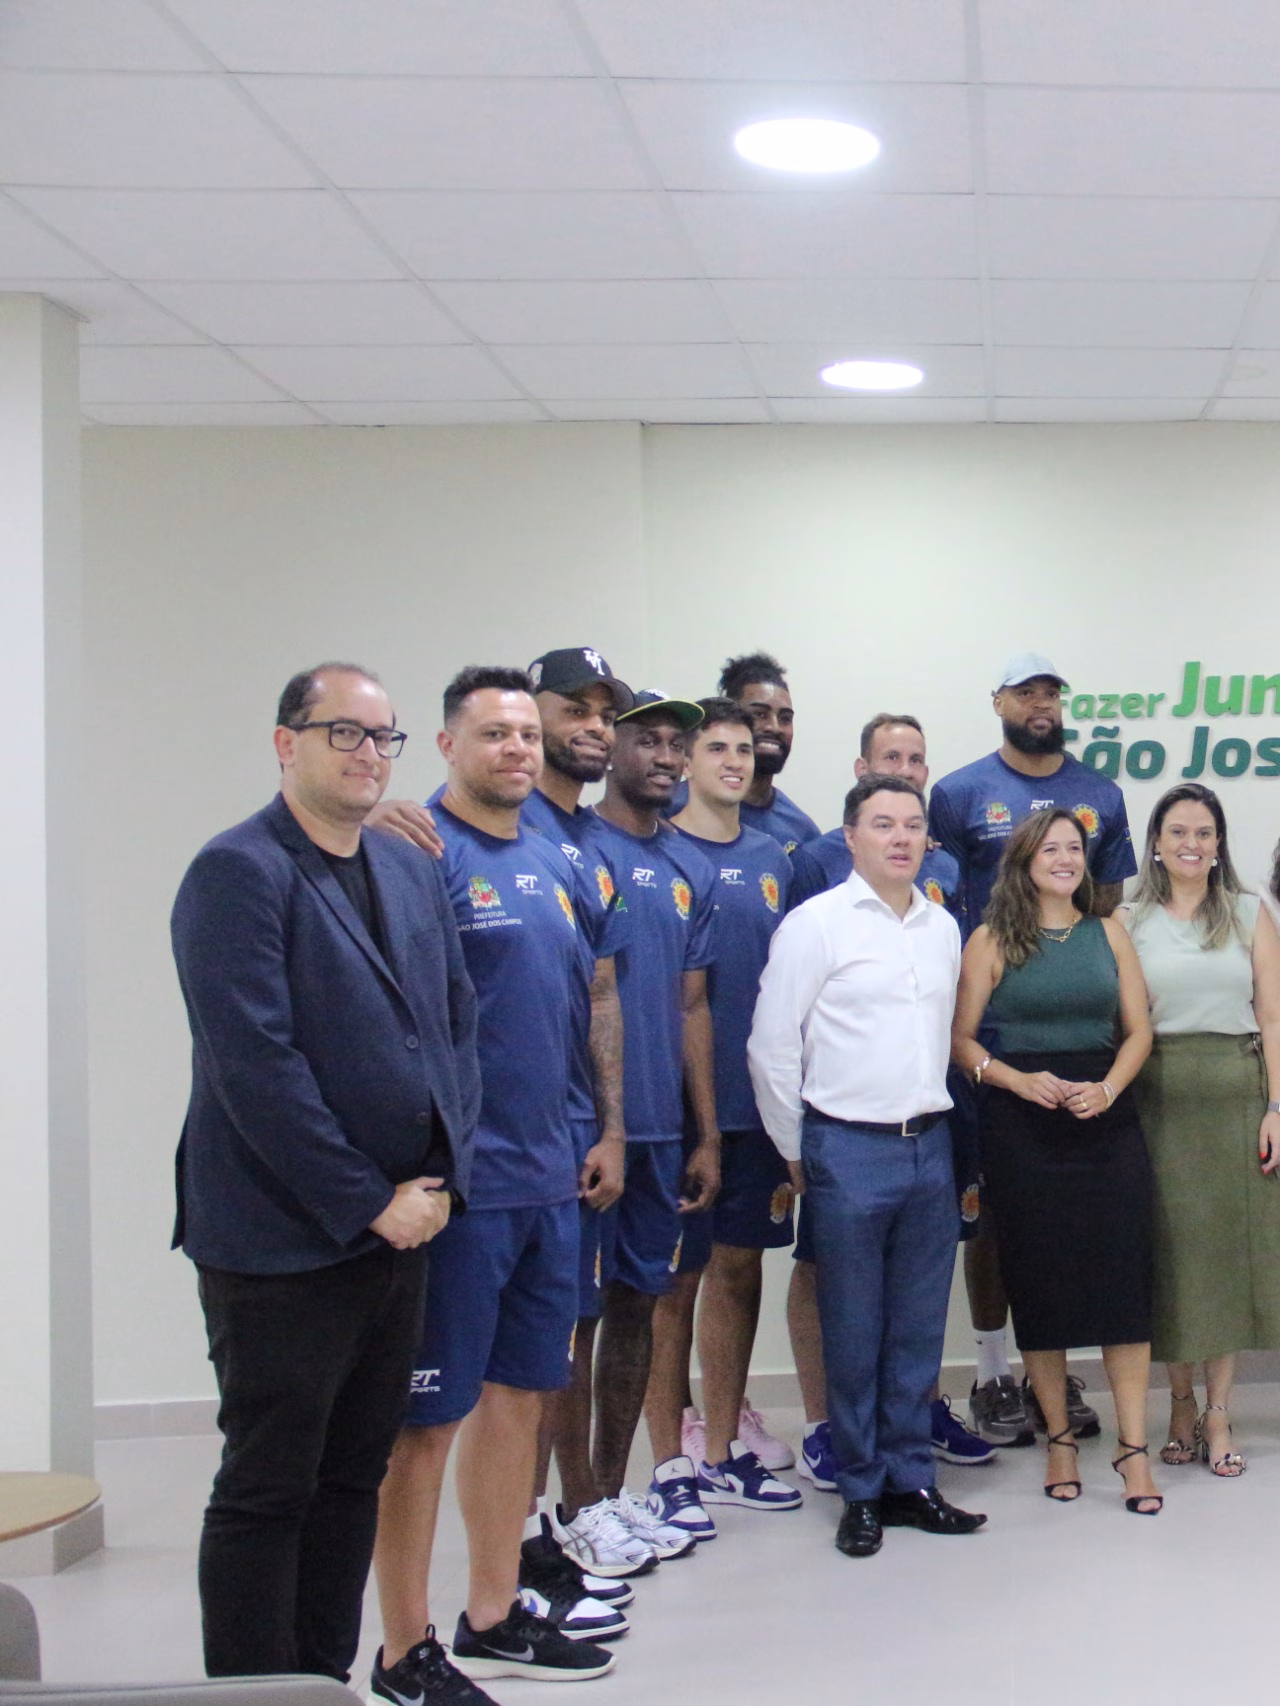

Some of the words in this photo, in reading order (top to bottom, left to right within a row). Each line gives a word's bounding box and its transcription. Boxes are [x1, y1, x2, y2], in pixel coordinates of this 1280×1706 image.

[515, 874, 538, 890] RT
[632, 867, 655, 882] RT
[720, 868, 742, 881] RT
